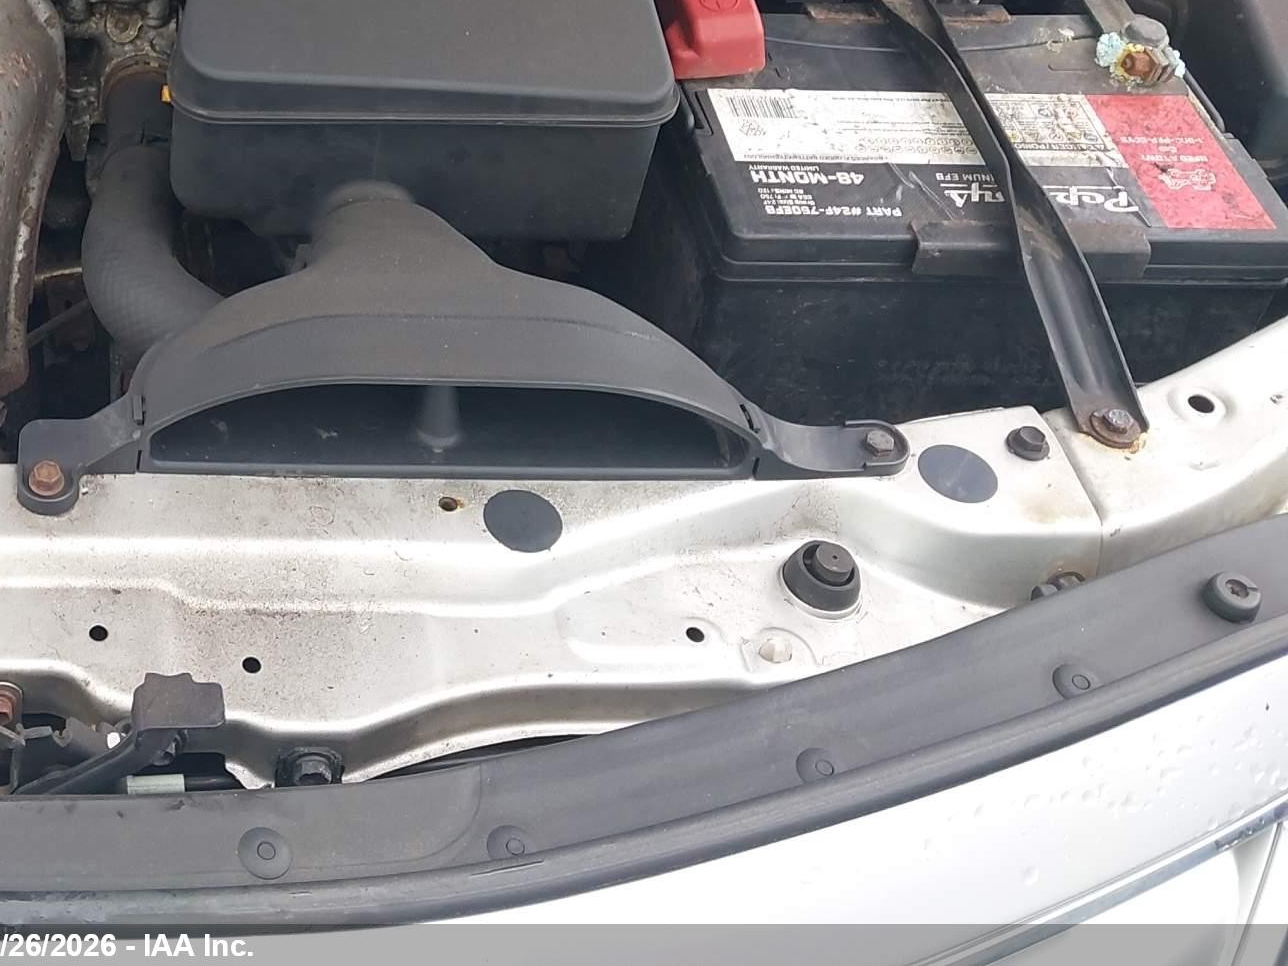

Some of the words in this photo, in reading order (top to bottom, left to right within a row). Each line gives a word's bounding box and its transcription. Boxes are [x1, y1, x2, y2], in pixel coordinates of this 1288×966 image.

[749, 170, 865, 185] 48-MONTH
[935, 172, 960, 181] EFB
[866, 206, 903, 217] PART
